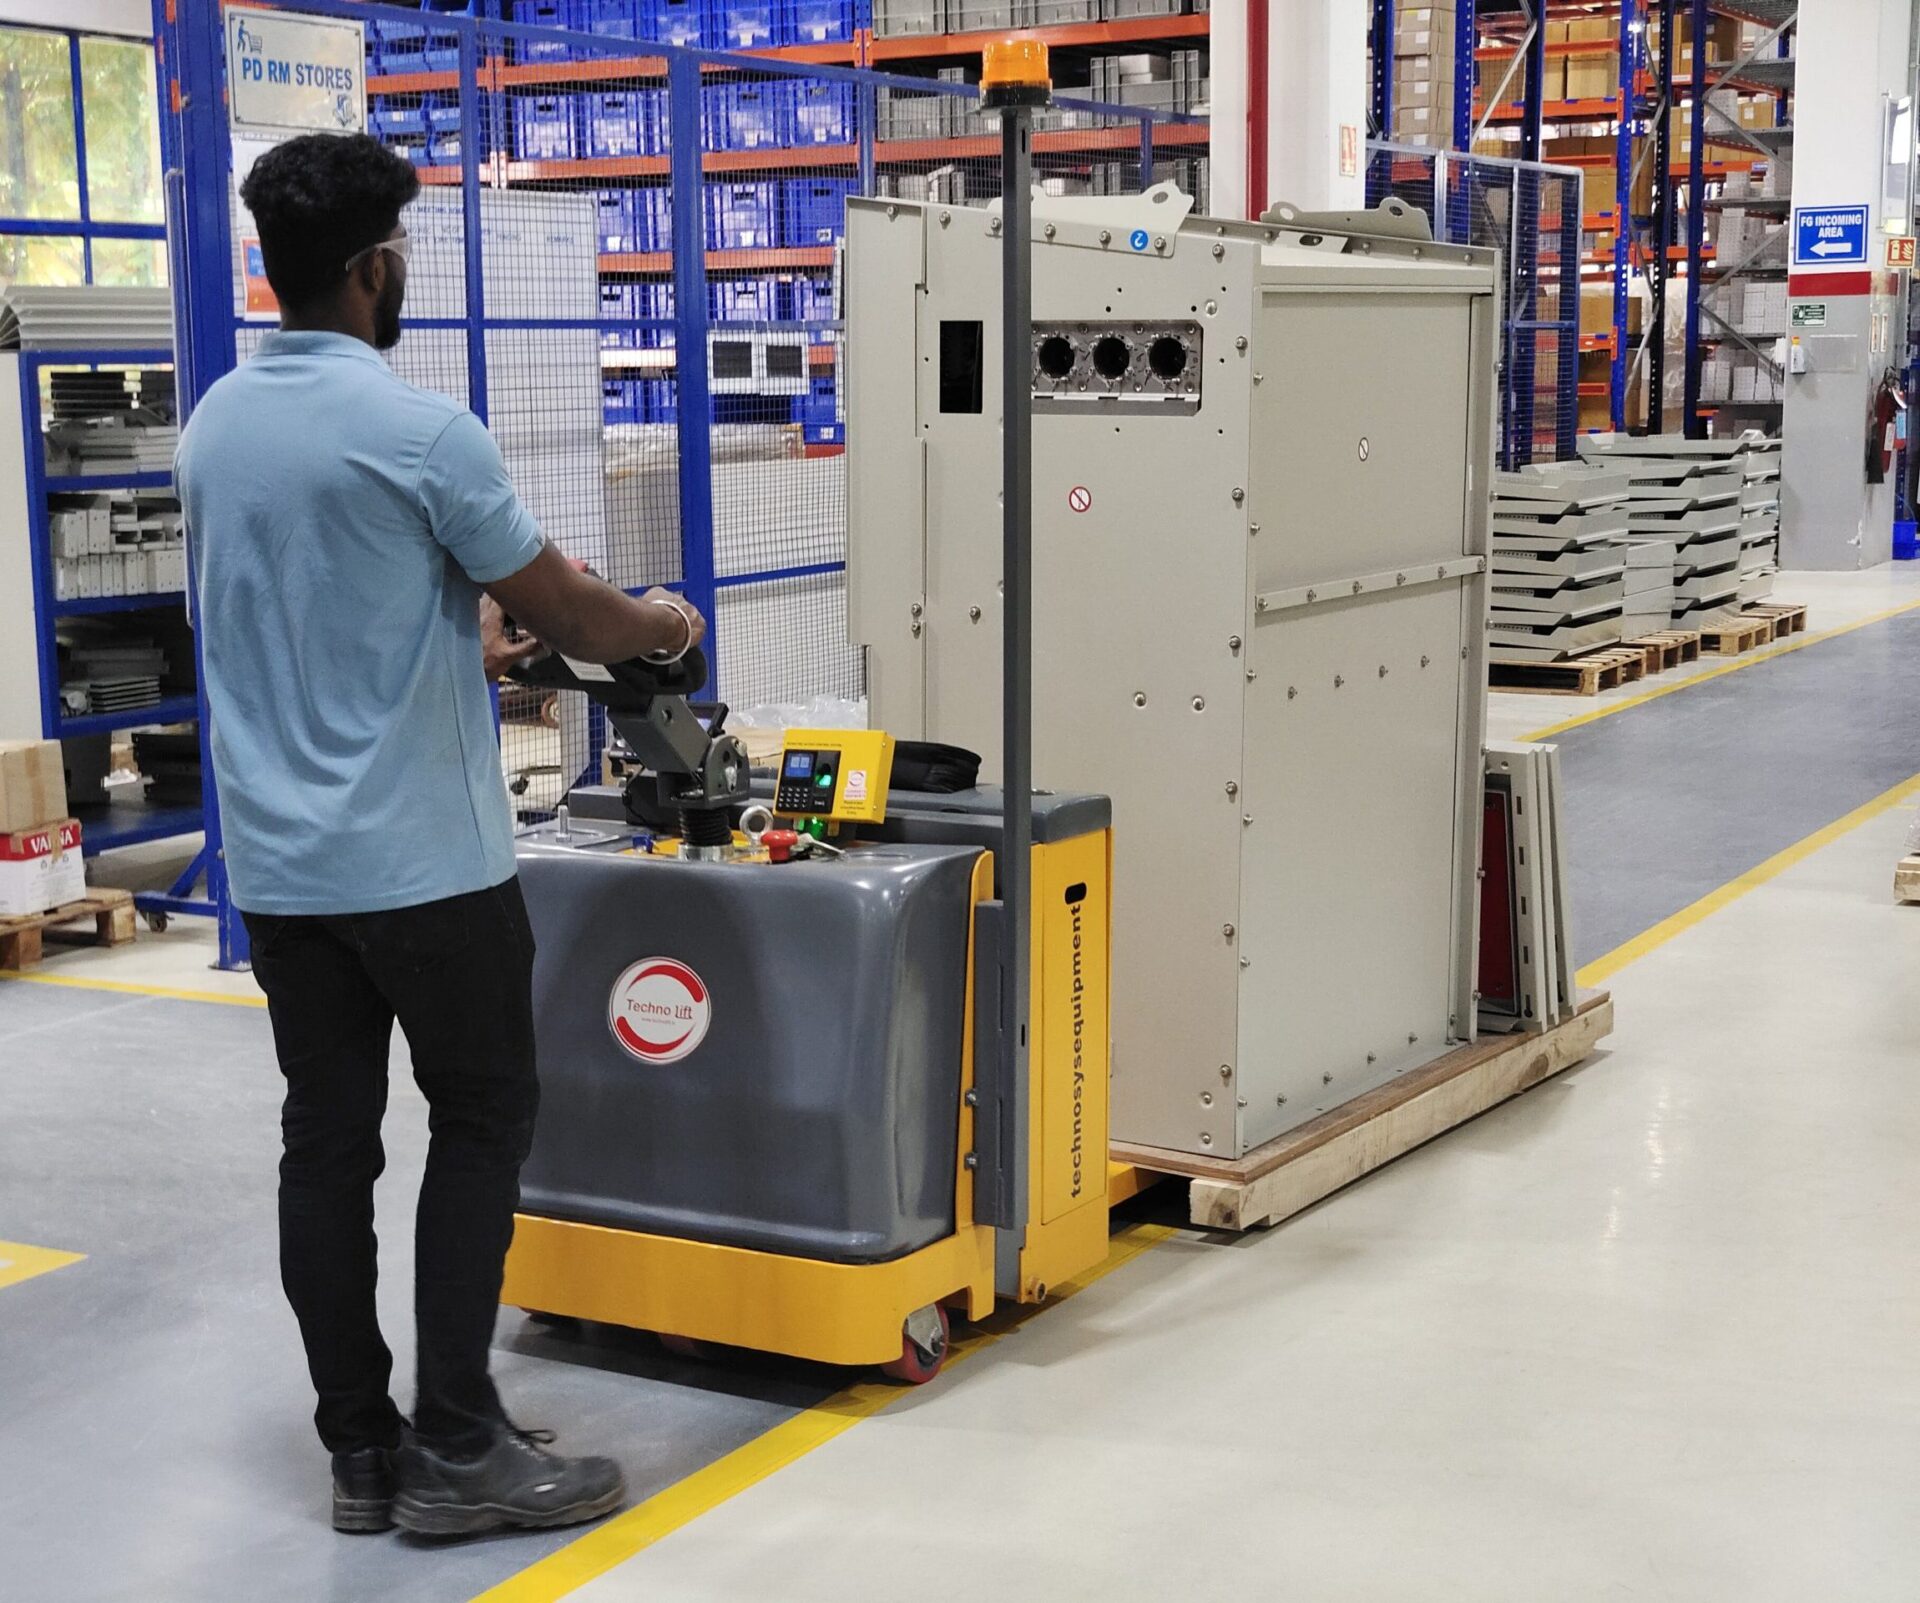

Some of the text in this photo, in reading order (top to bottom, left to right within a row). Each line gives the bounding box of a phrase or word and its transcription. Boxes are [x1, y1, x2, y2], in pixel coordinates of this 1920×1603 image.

[242, 57, 353, 91] PD RM STORES
[1800, 214, 1862, 227] FG INCOMING
[1818, 227, 1844, 238] AREA
[626, 998, 671, 1016] Techno
[1070, 903, 1085, 1199] technosysequipment
